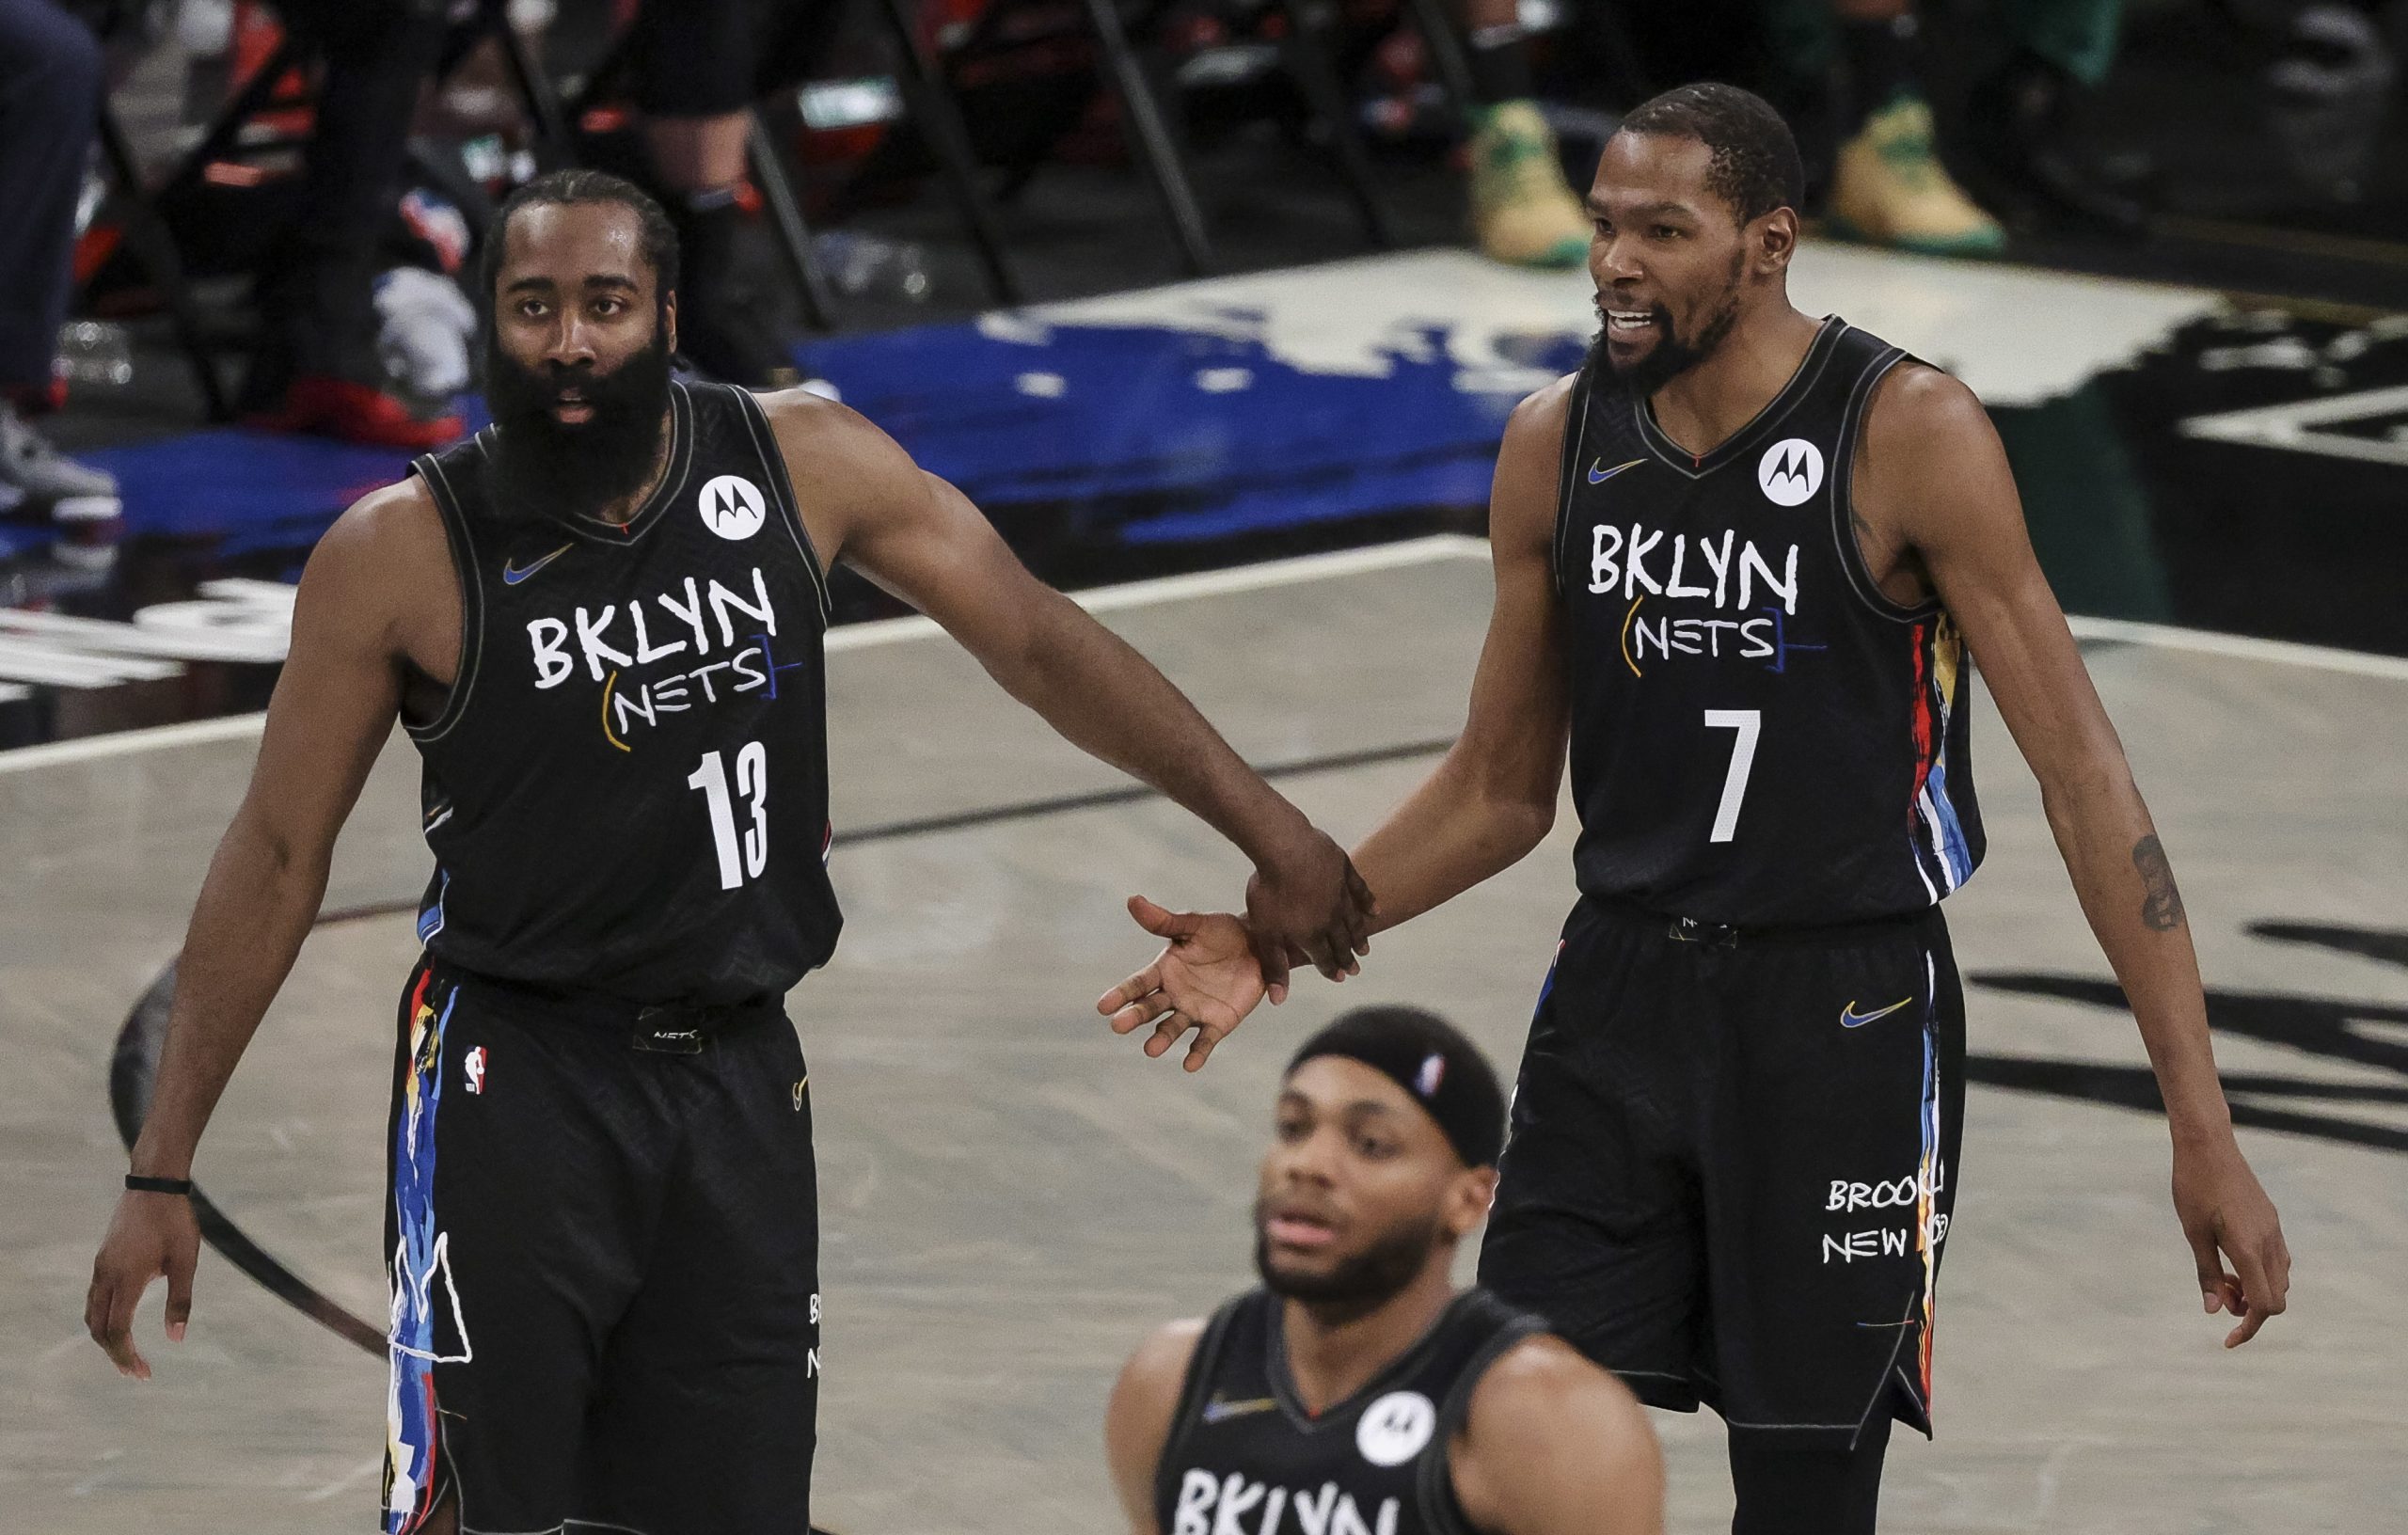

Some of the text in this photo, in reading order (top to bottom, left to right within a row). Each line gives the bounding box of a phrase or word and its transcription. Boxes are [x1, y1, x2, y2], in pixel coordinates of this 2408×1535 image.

[527, 567, 776, 688] BKLYN
[1588, 523, 1798, 615] BKLYN
[688, 740, 768, 890] 13
[1704, 709, 1762, 843] 7
[1822, 1227, 1907, 1263] NEW
